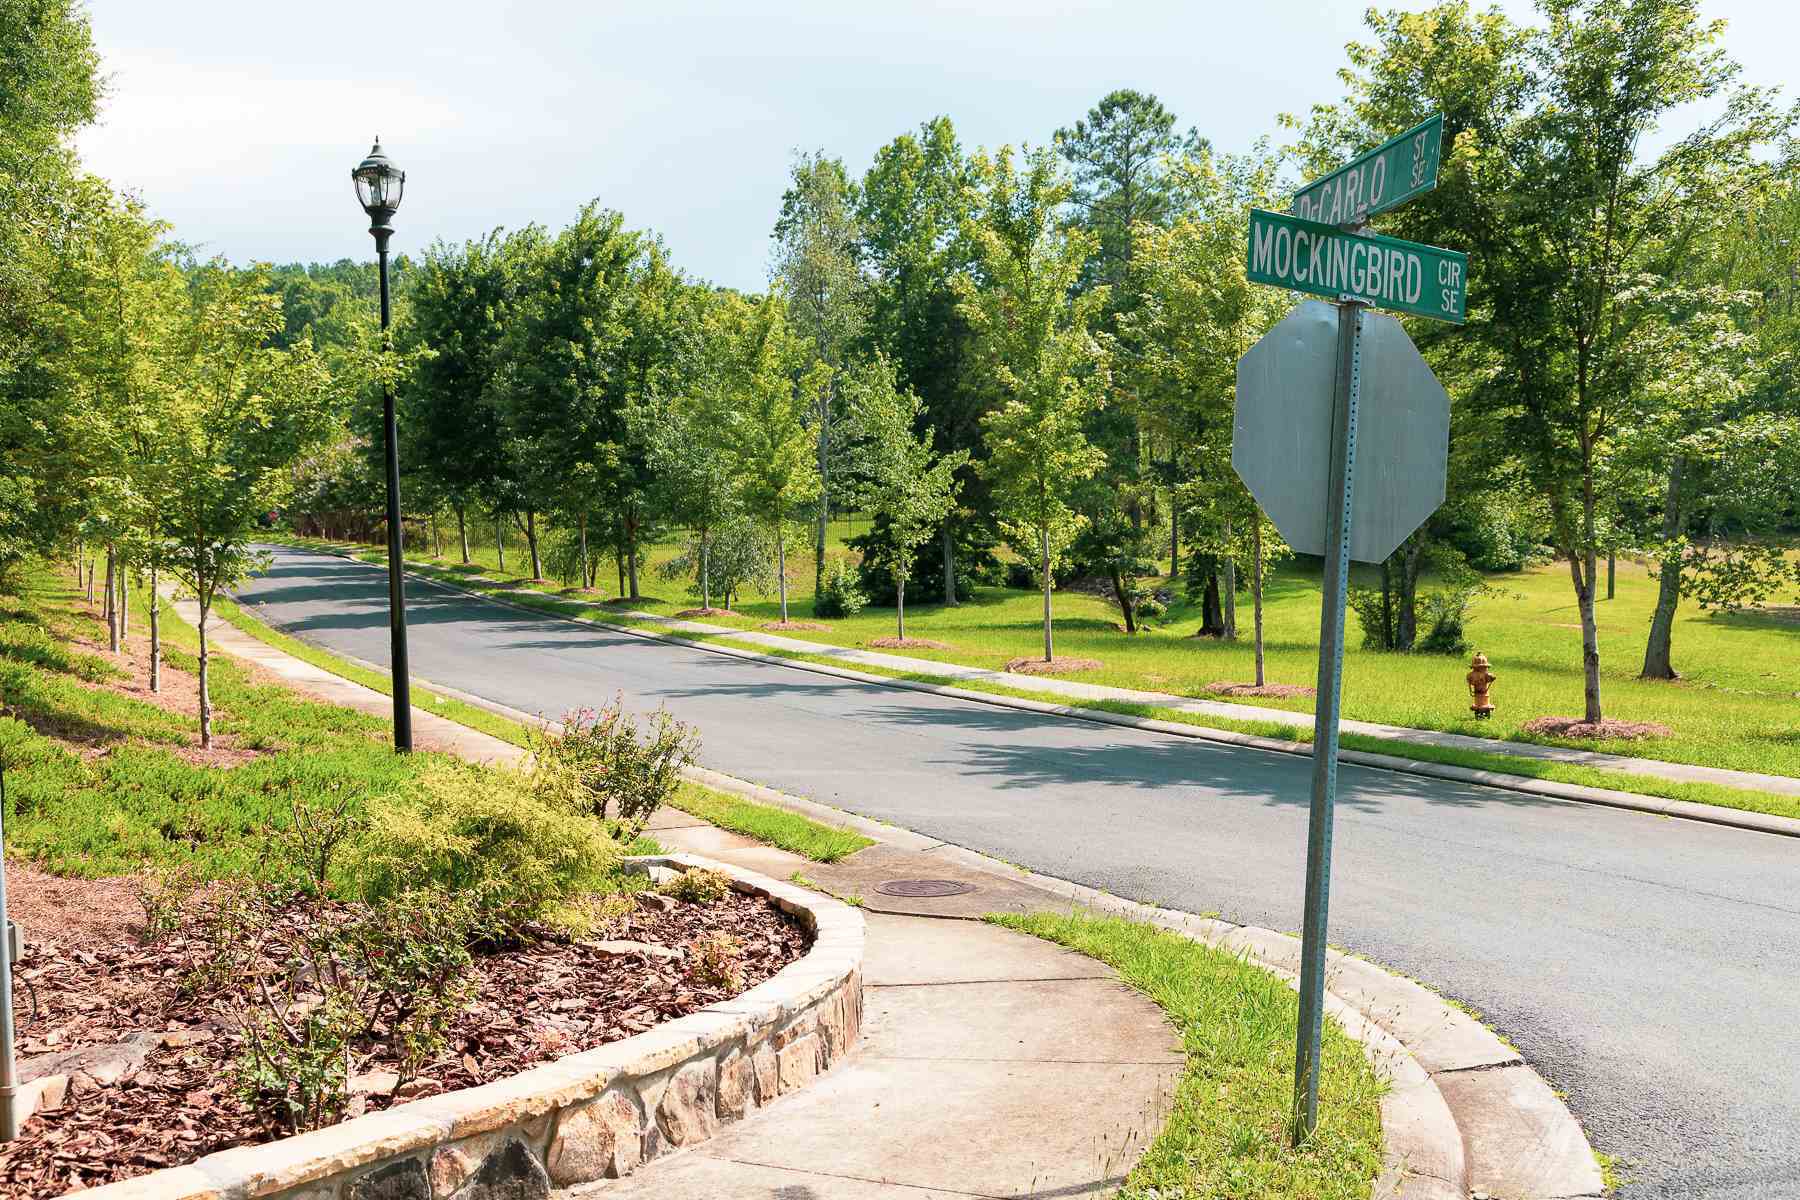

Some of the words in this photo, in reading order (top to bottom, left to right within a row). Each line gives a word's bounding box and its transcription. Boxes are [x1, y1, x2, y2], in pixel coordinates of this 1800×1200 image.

[1413, 131, 1429, 161] ST
[1410, 160, 1425, 188] SE
[1253, 222, 1422, 304] MOCKINGBIRD
[1438, 259, 1461, 289] CIR
[1441, 290, 1459, 314] SE
